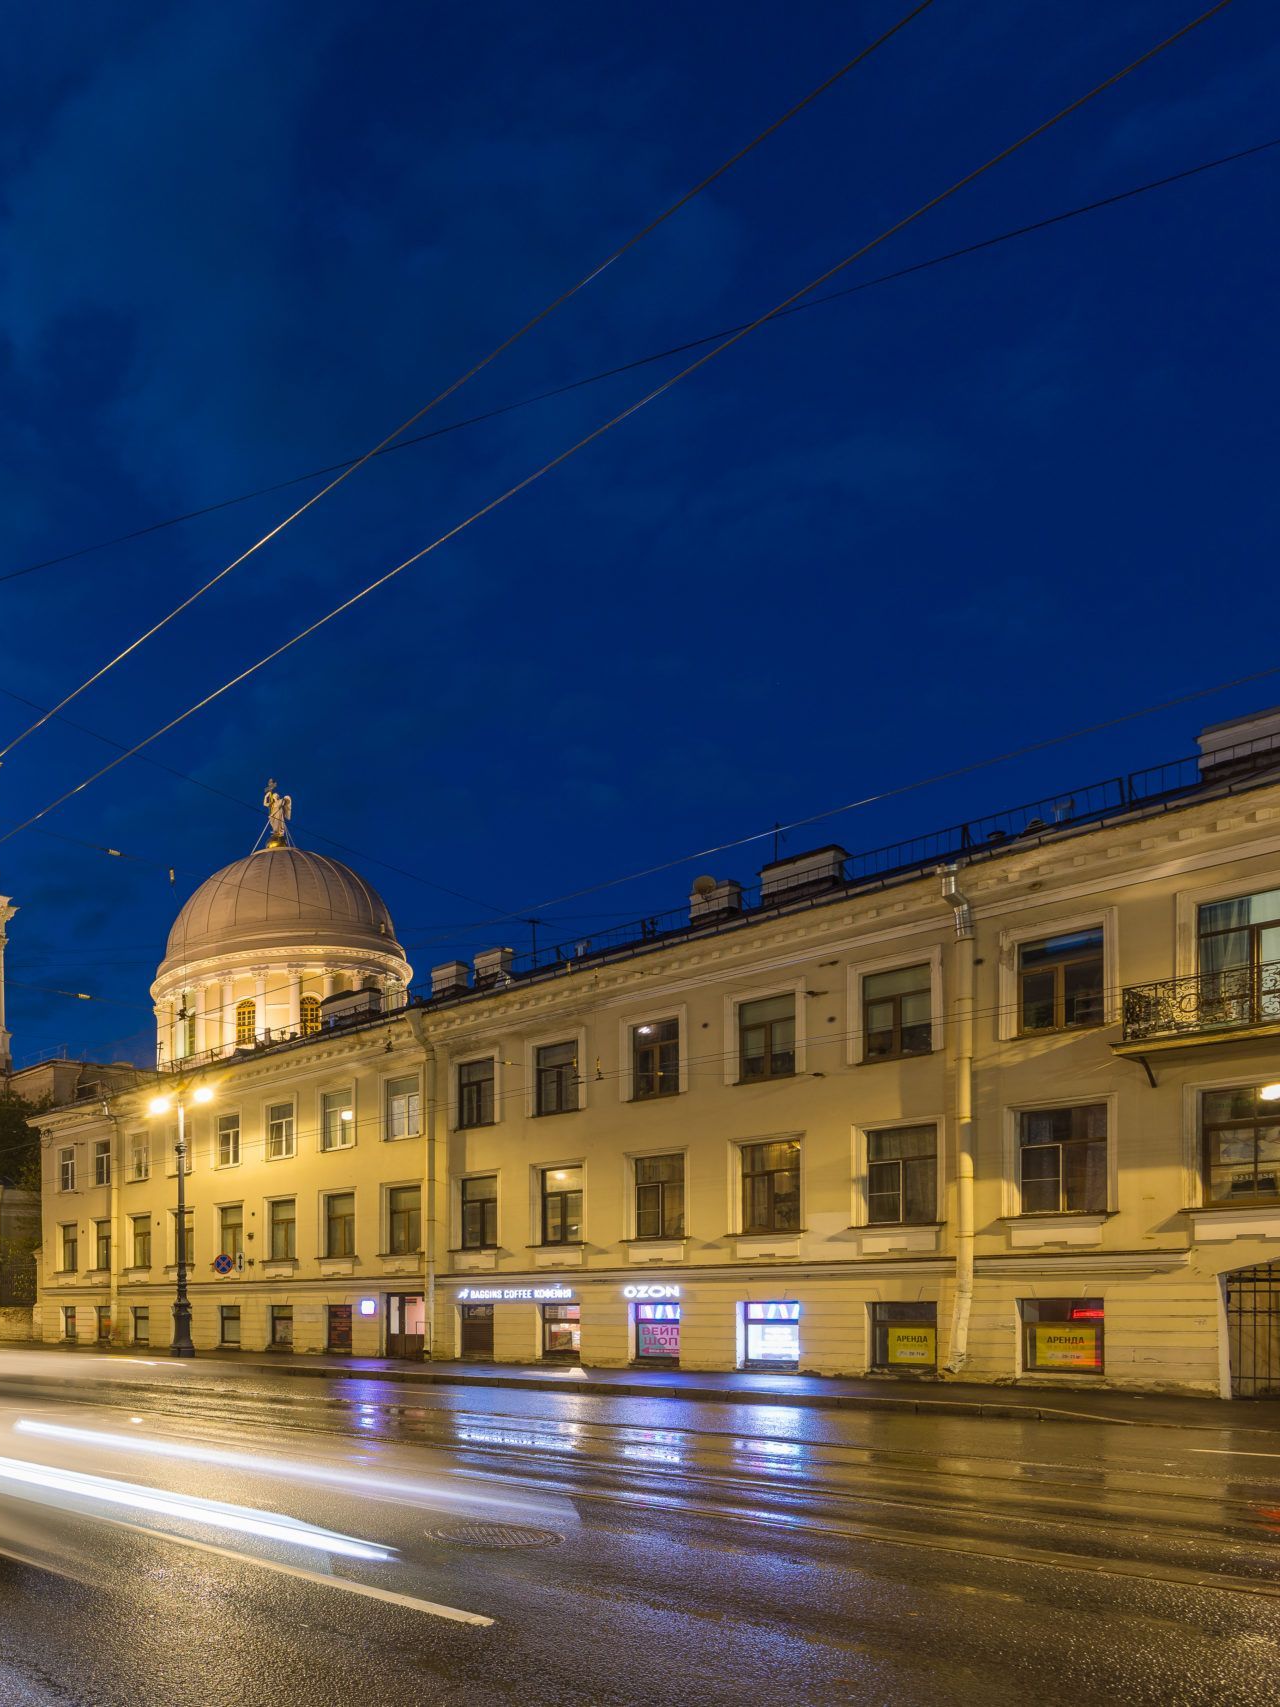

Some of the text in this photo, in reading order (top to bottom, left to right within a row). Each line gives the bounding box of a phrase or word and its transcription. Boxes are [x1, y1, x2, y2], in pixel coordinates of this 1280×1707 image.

[470, 1289, 501, 1299] BAGGINS
[503, 1289, 533, 1298] COFFEE
[623, 1285, 680, 1298] OZON
[641, 1325, 680, 1336] ВЕЙП
[643, 1337, 679, 1346] ШОП
[896, 1335, 928, 1343] АРЕНДА
[1046, 1336, 1085, 1345] АРЕНДА
